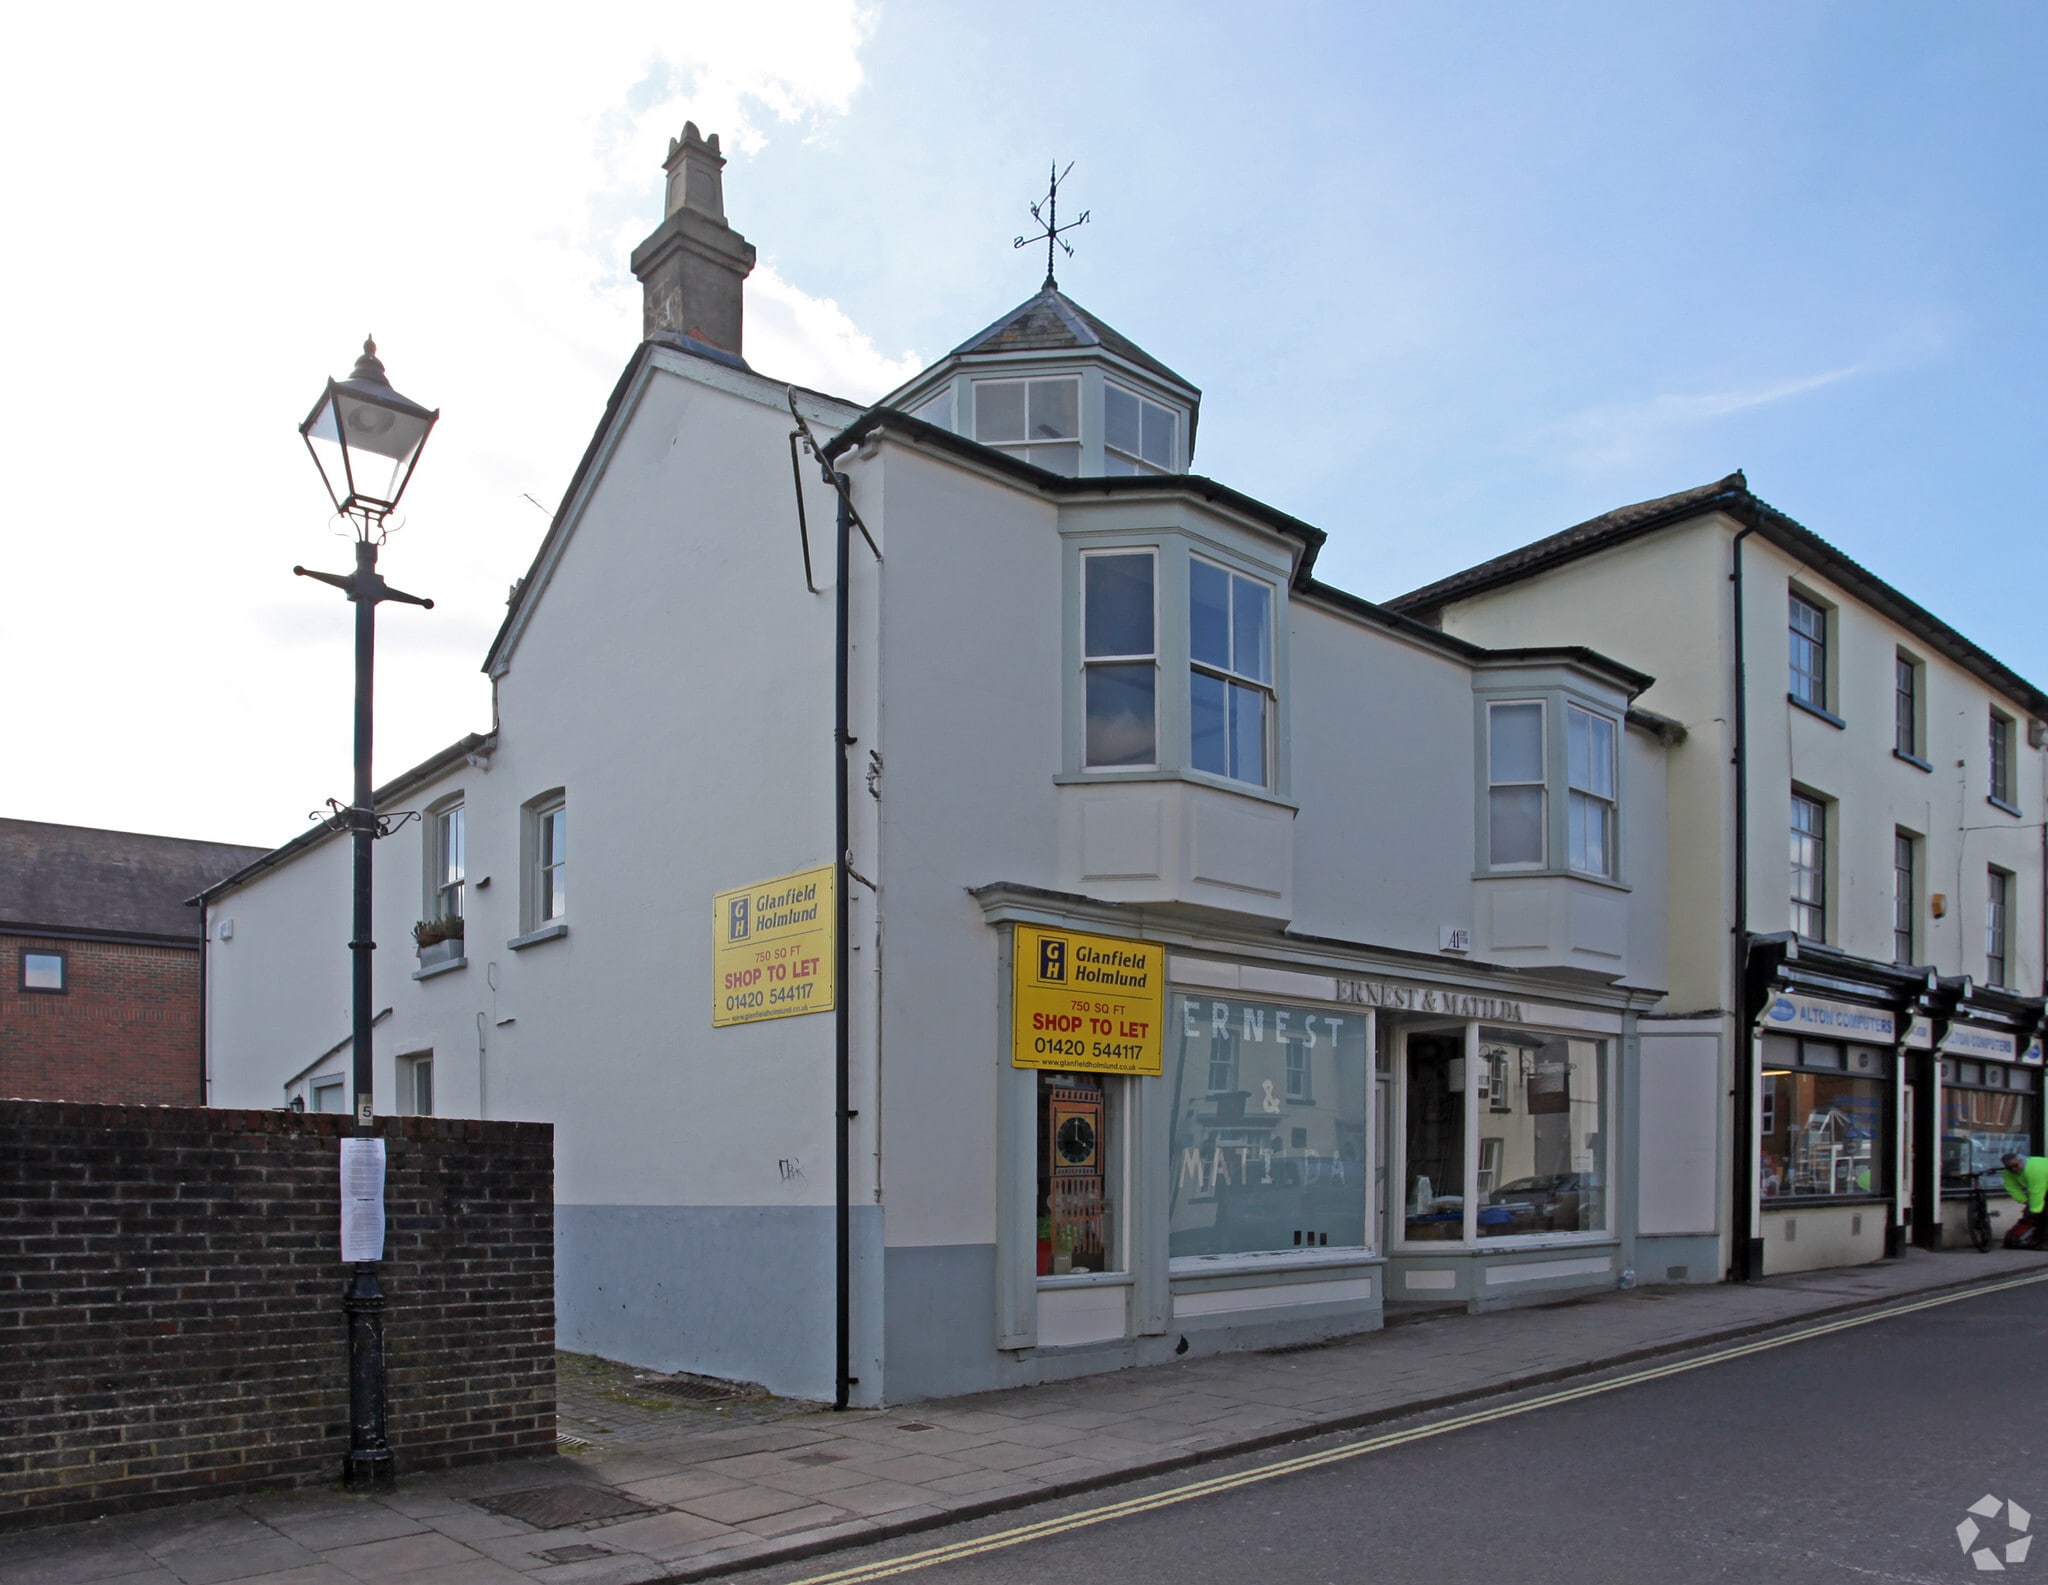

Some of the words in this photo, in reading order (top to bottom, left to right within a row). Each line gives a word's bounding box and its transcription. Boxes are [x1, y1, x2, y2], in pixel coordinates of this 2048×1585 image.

[735, 901, 744, 918] G
[756, 884, 816, 912] Glanfield
[735, 920, 745, 937] H
[756, 904, 817, 932] Holmlund
[755, 951, 771, 963] 750
[774, 948, 787, 960] SQ
[790, 945, 801, 956] FT
[1046, 943, 1059, 960] G
[1076, 946, 1146, 969] Glanfield
[725, 968, 762, 990] SHOP
[767, 963, 786, 982] TO
[792, 957, 820, 978] LET
[1046, 962, 1060, 979] H
[1075, 965, 1147, 988] Holmlund
[726, 990, 764, 1011] 01420
[769, 982, 814, 1004] 544117
[1071, 1000, 1090, 1012] 750
[1094, 1003, 1109, 1014] SQ
[1113, 1005, 1126, 1016] FT
[1336, 979, 1418, 1009] ERNEST
[1423, 991, 1437, 1012] &
[1443, 993, 1523, 1021] MATILDA
[1032, 1012, 1083, 1033] SHOP
[1090, 1018, 1112, 1036] TO
[1119, 1021, 1149, 1039] LET
[1183, 1000, 1344, 1048] ERNEST
[1800, 1006, 1833, 1025] ALTON
[1836, 1012, 1893, 1034] COMPUTERS
[1034, 1037, 1085, 1056] 01420
[1092, 1043, 1143, 1060] 544117
[1042, 1058, 1136, 1071] www.glanfieldholmlund.co.uk
[1262, 1079, 1280, 1114] &
[362, 1106, 372, 1118] 5
